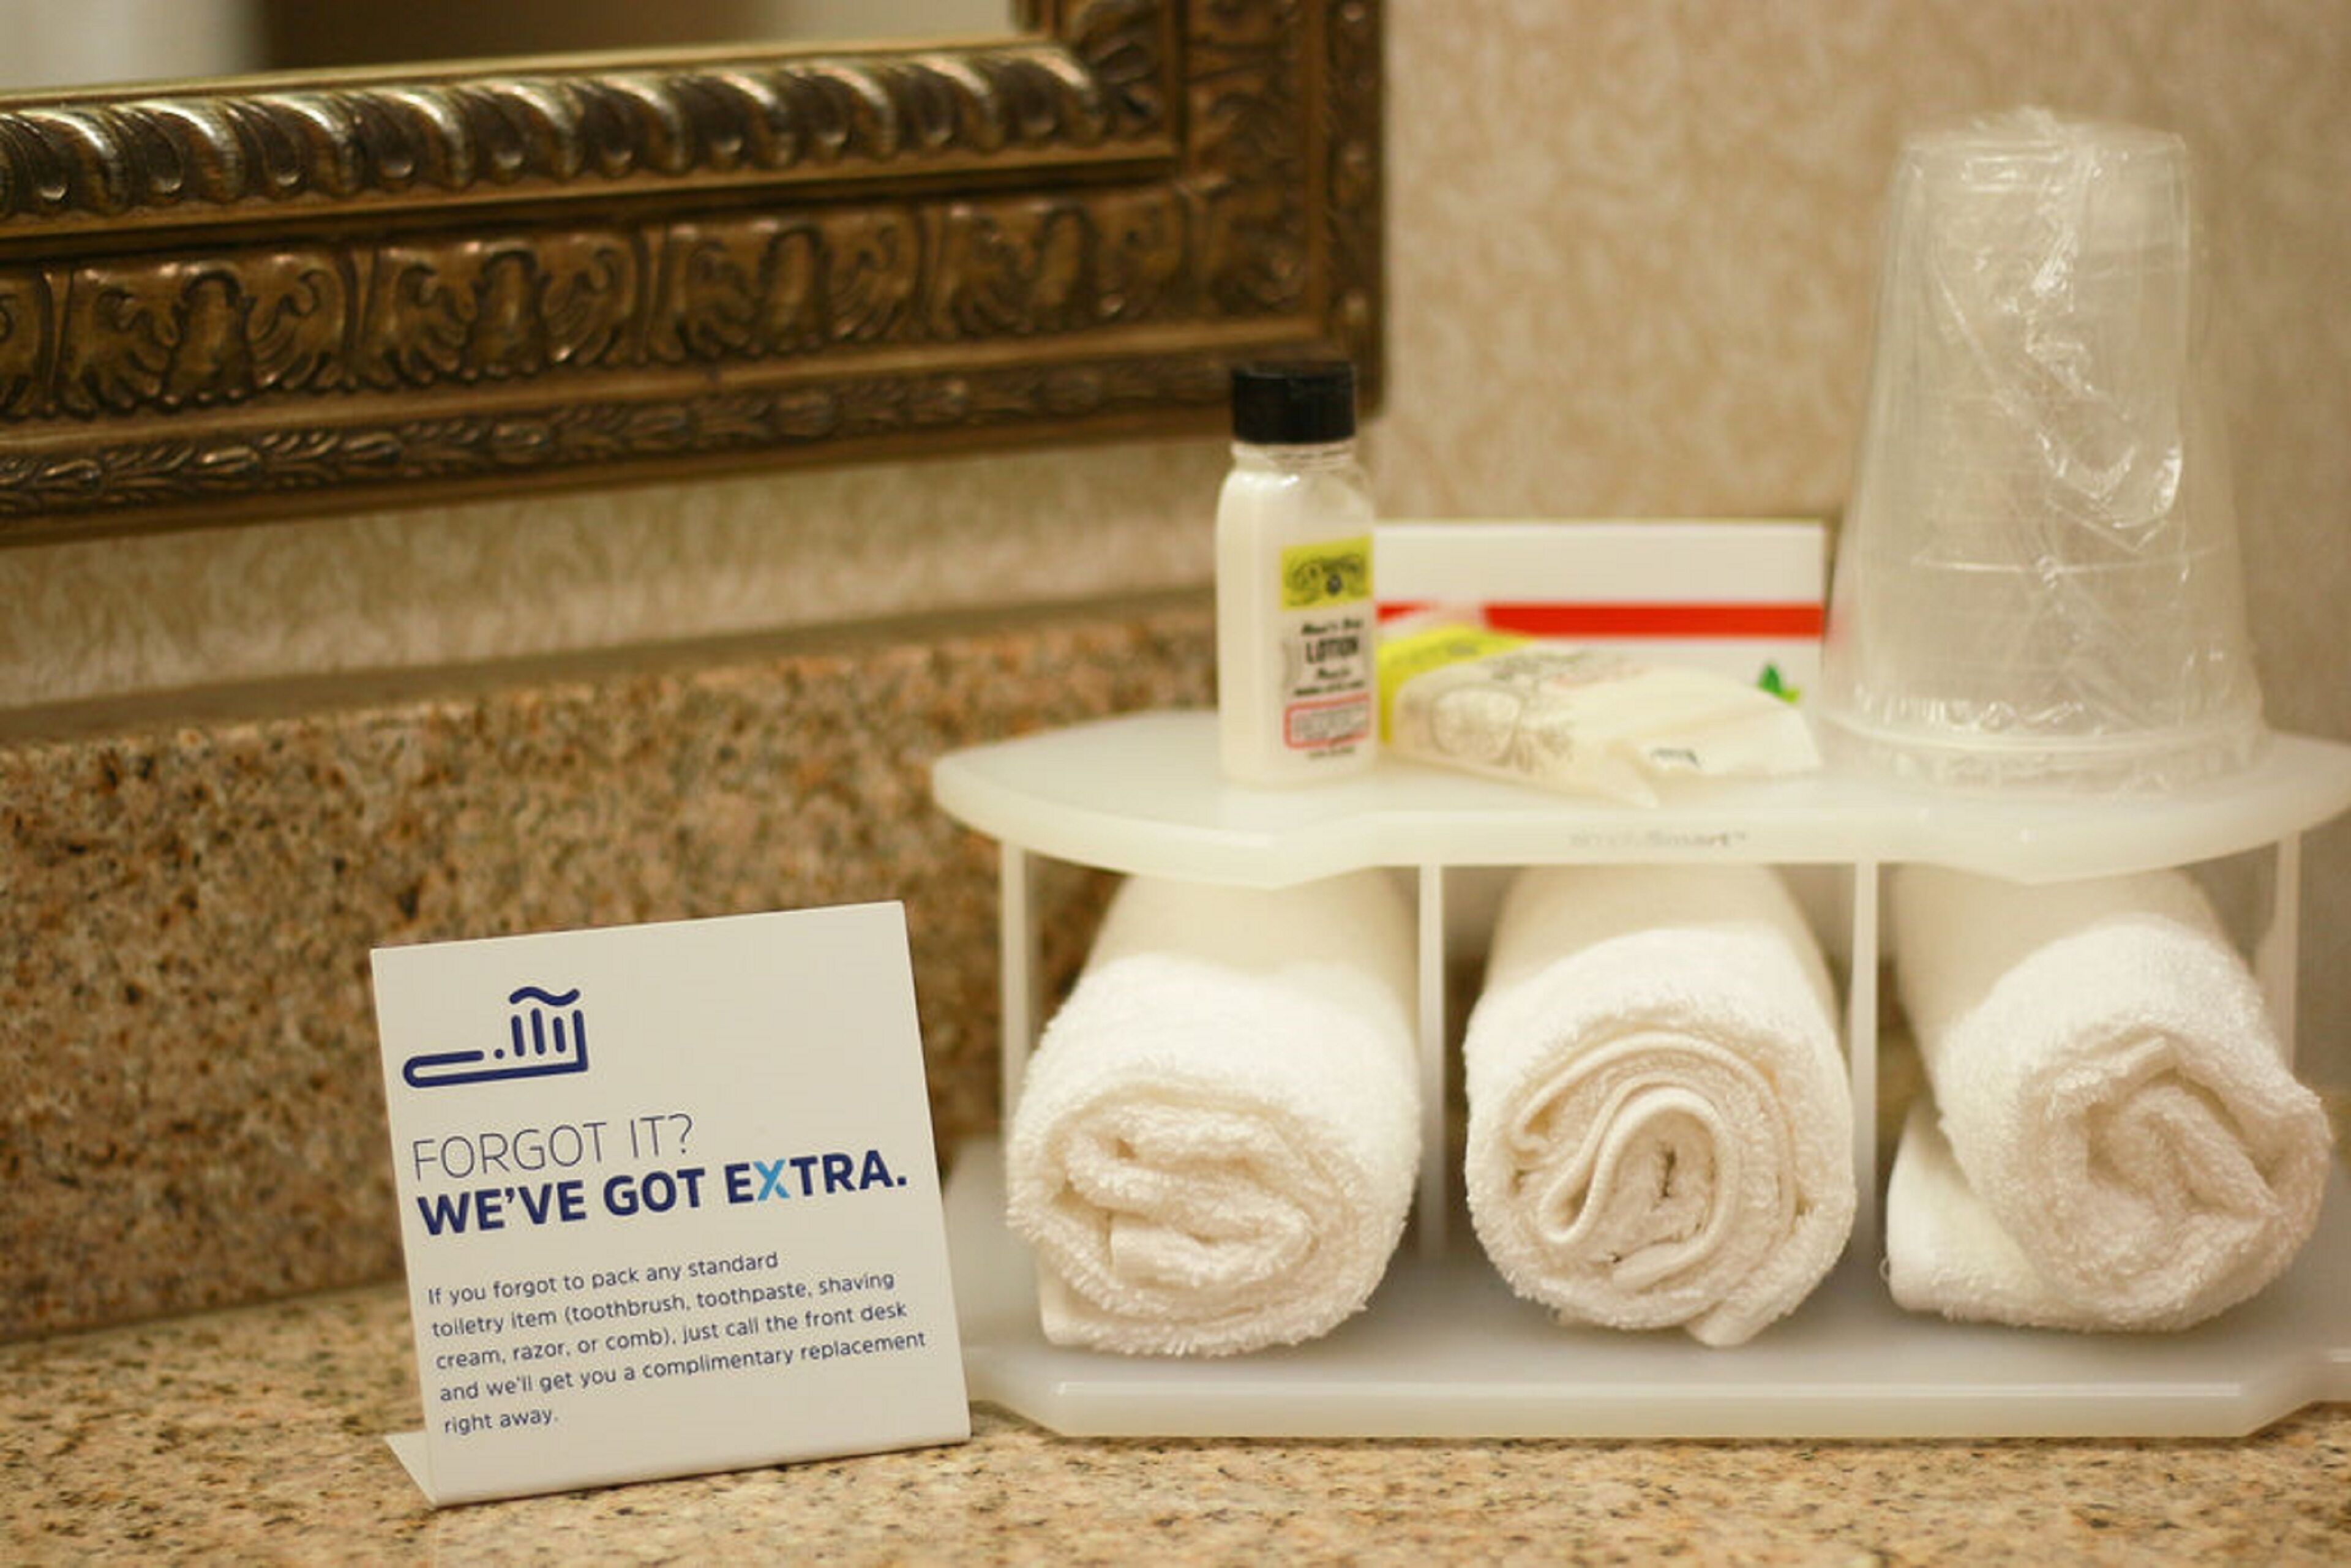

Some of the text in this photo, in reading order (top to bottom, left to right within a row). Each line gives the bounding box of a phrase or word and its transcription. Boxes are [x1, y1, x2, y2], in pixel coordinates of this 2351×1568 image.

[412, 1114, 694, 1181] FORGOT IT?
[416, 1150, 907, 1236] WE’VE GOT EXTRA.
[429, 1251, 778, 1306] If you forgot to pack any standard
[432, 1274, 894, 1337] toiletry item (toothbrush, toothpaste, shaving
[437, 1302, 907, 1370] cream, razor, or comb), just call the front desk
[440, 1332, 926, 1401] and we'll get you a complimentary replacement
[444, 1409, 558, 1436] right away.
